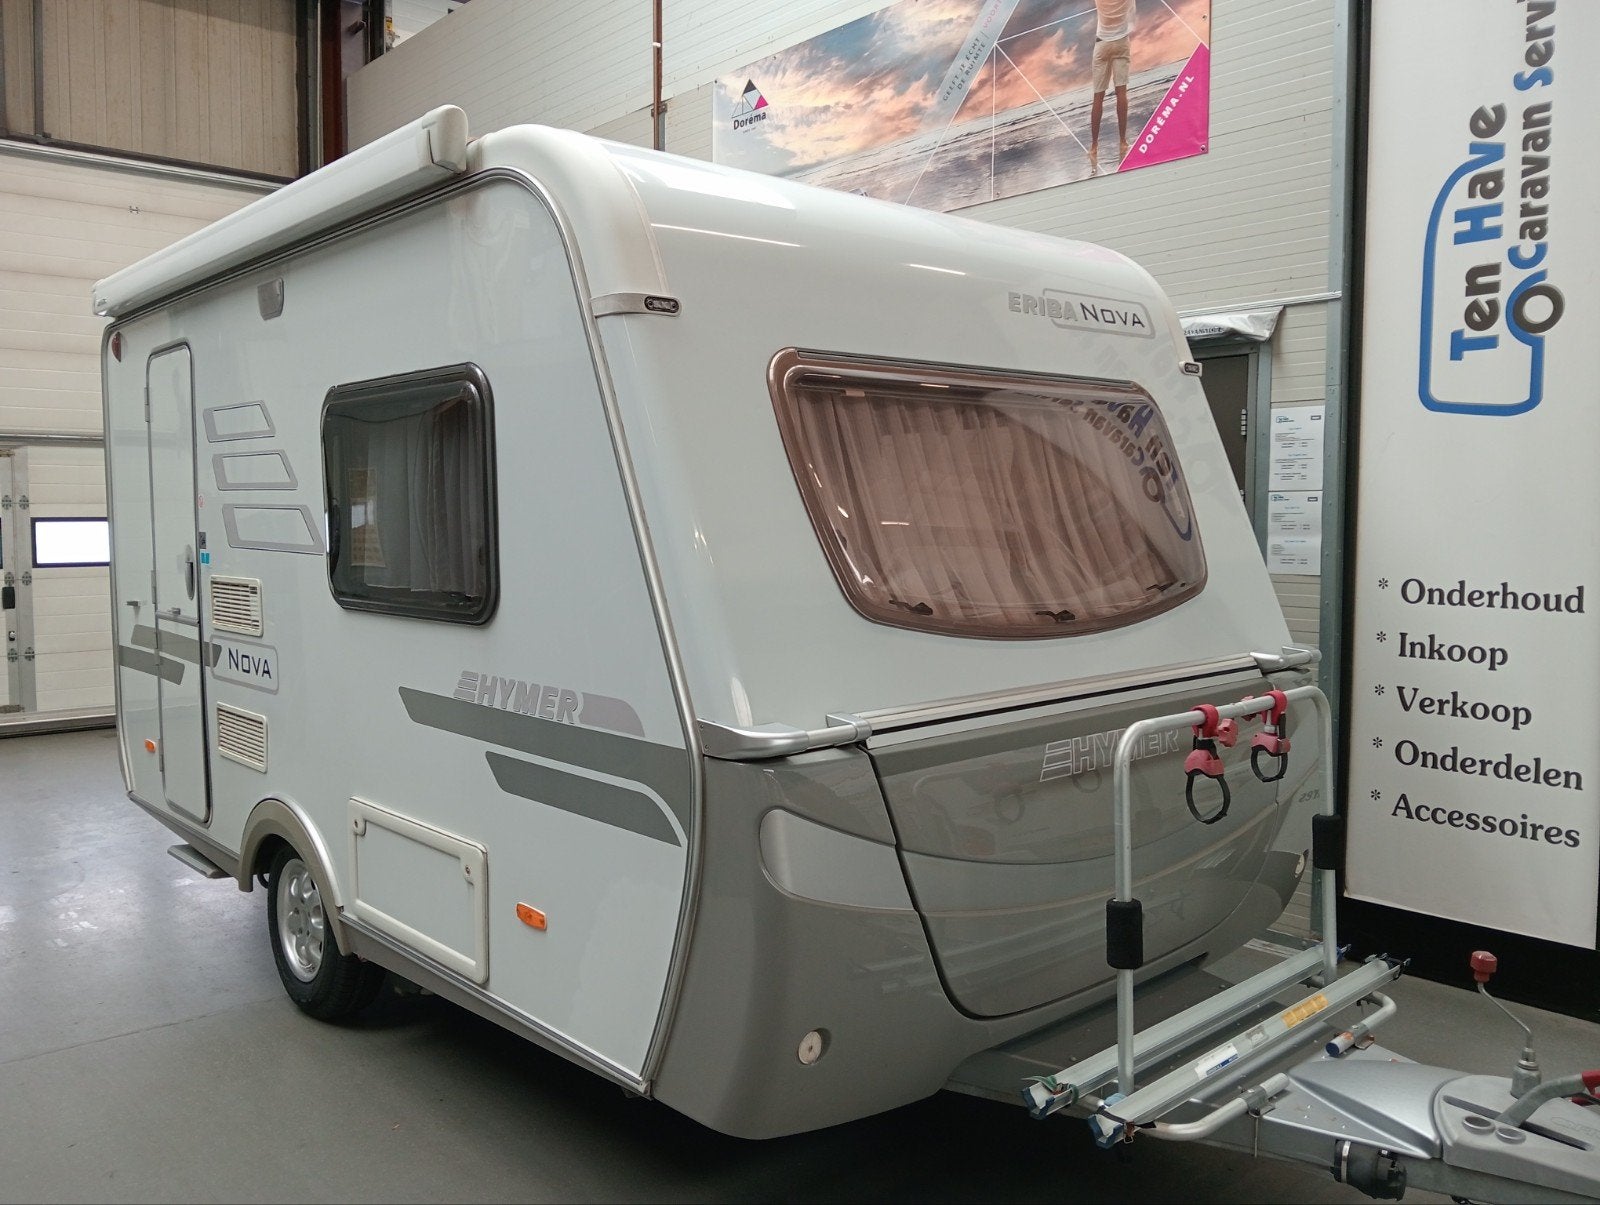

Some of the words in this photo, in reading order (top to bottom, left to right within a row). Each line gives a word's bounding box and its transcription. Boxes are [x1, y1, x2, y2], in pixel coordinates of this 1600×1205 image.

[1513, 0, 1557, 91] Serv
[1507, 100, 1553, 270] Caravan
[1008, 291, 1078, 322] ERIBA
[1080, 302, 1146, 328] NOVA
[1450, 262, 1502, 361] Ten
[1401, 578, 1585, 613] Onderhoud
[228, 647, 272, 679] NOVA
[1398, 632, 1508, 671] Inkoop
[476, 673, 579, 725] HYMER
[1396, 686, 1532, 730] Verkoop
[1395, 739, 1583, 790] Onderdelen
[1391, 793, 1581, 848] Accessoires
